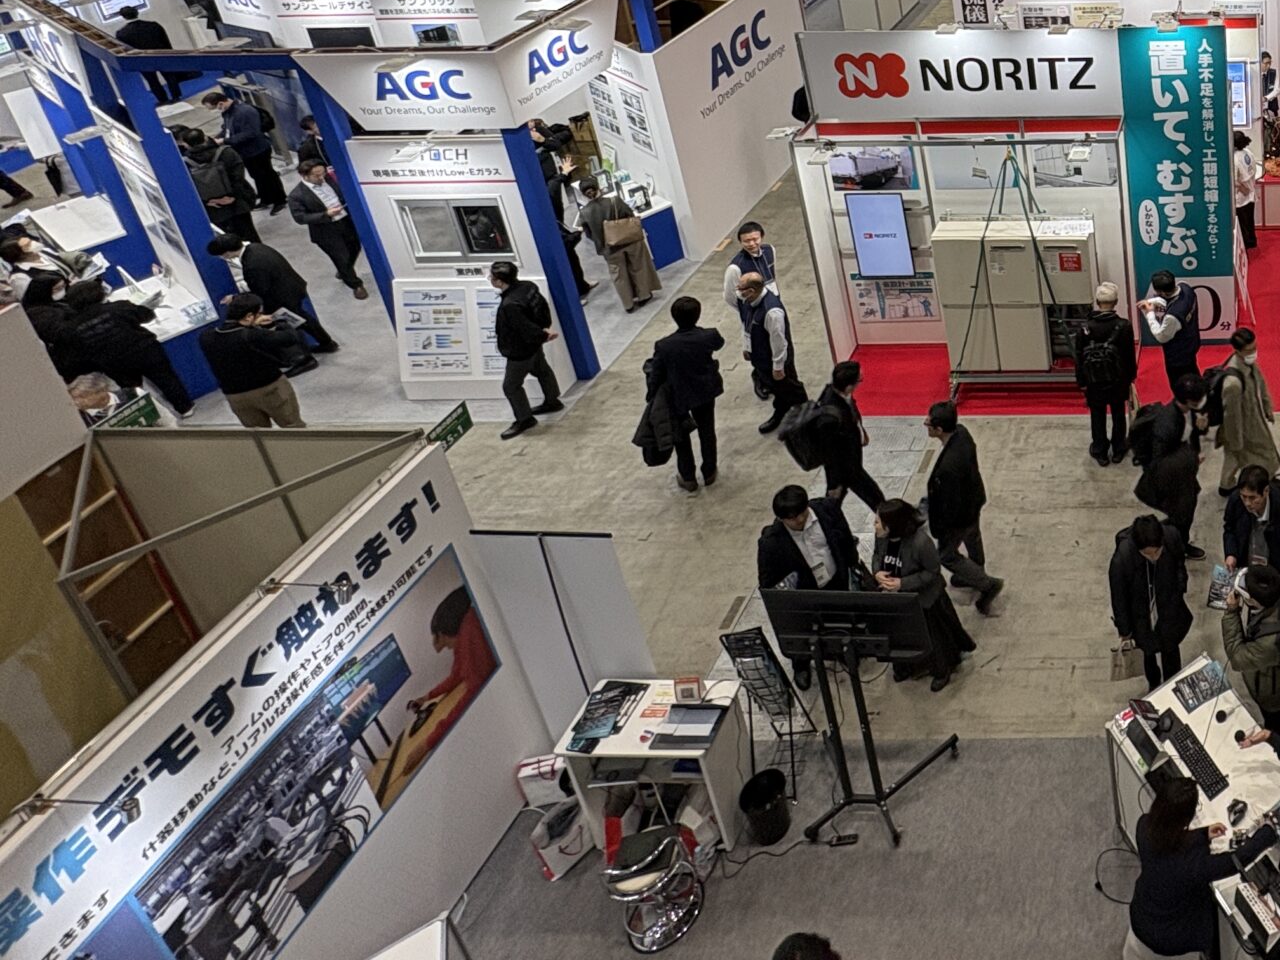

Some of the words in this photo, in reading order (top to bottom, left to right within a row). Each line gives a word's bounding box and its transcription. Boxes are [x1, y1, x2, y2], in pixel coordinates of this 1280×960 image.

[517, 91, 537, 107] Your
[562, 71, 576, 85] Our
[575, 49, 604, 79] Challenge
[527, 30, 590, 85] AGC
[711, 9, 771, 92] AGC
[919, 56, 1097, 93] NORITZ
[376, 68, 472, 102] AGC
[700, 100, 718, 120] Your
[744, 69, 757, 82] Our
[757, 43, 787, 74] Challenge
[360, 106, 384, 117] Your
[385, 106, 425, 117] Dreams,
[427, 106, 447, 116] Our
[448, 103, 496, 118] Challenge
[372, 169, 502, 178] 現場施工型後付けLow-Eガラス
[1148, 40, 1199, 271] 置いて、むすぶ。
